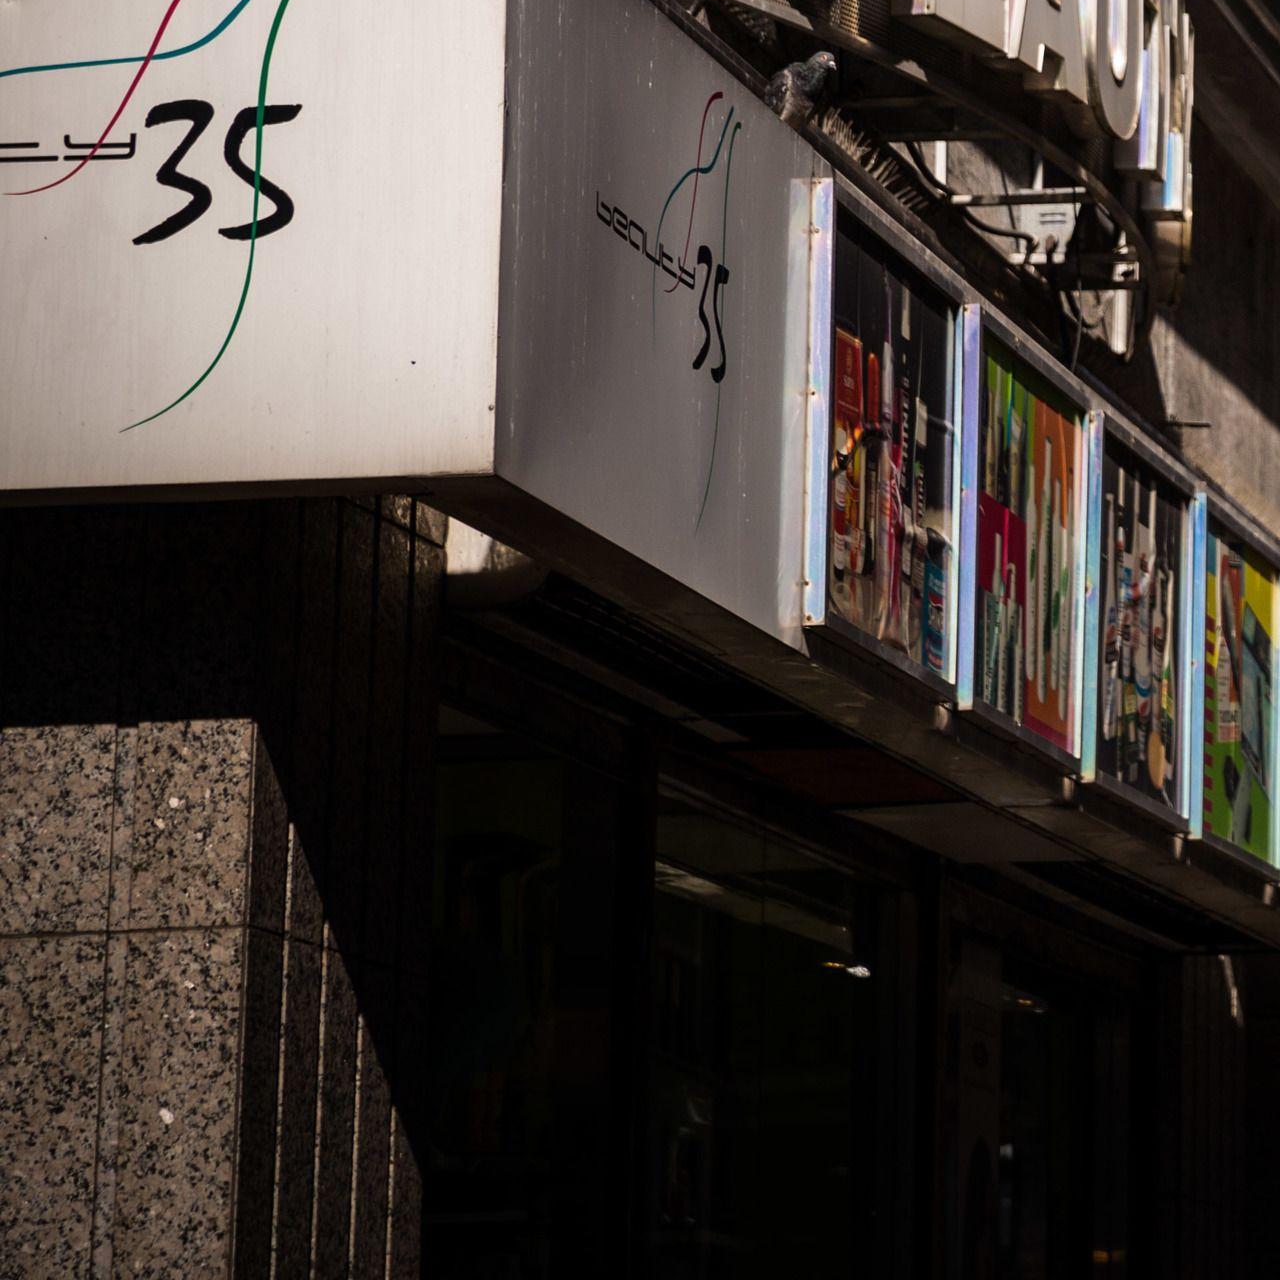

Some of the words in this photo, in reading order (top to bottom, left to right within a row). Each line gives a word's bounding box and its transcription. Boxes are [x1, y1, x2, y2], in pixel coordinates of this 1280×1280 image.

[132, 99, 303, 246] 35
[595, 190, 696, 290] beauty
[692, 245, 730, 384] 35
